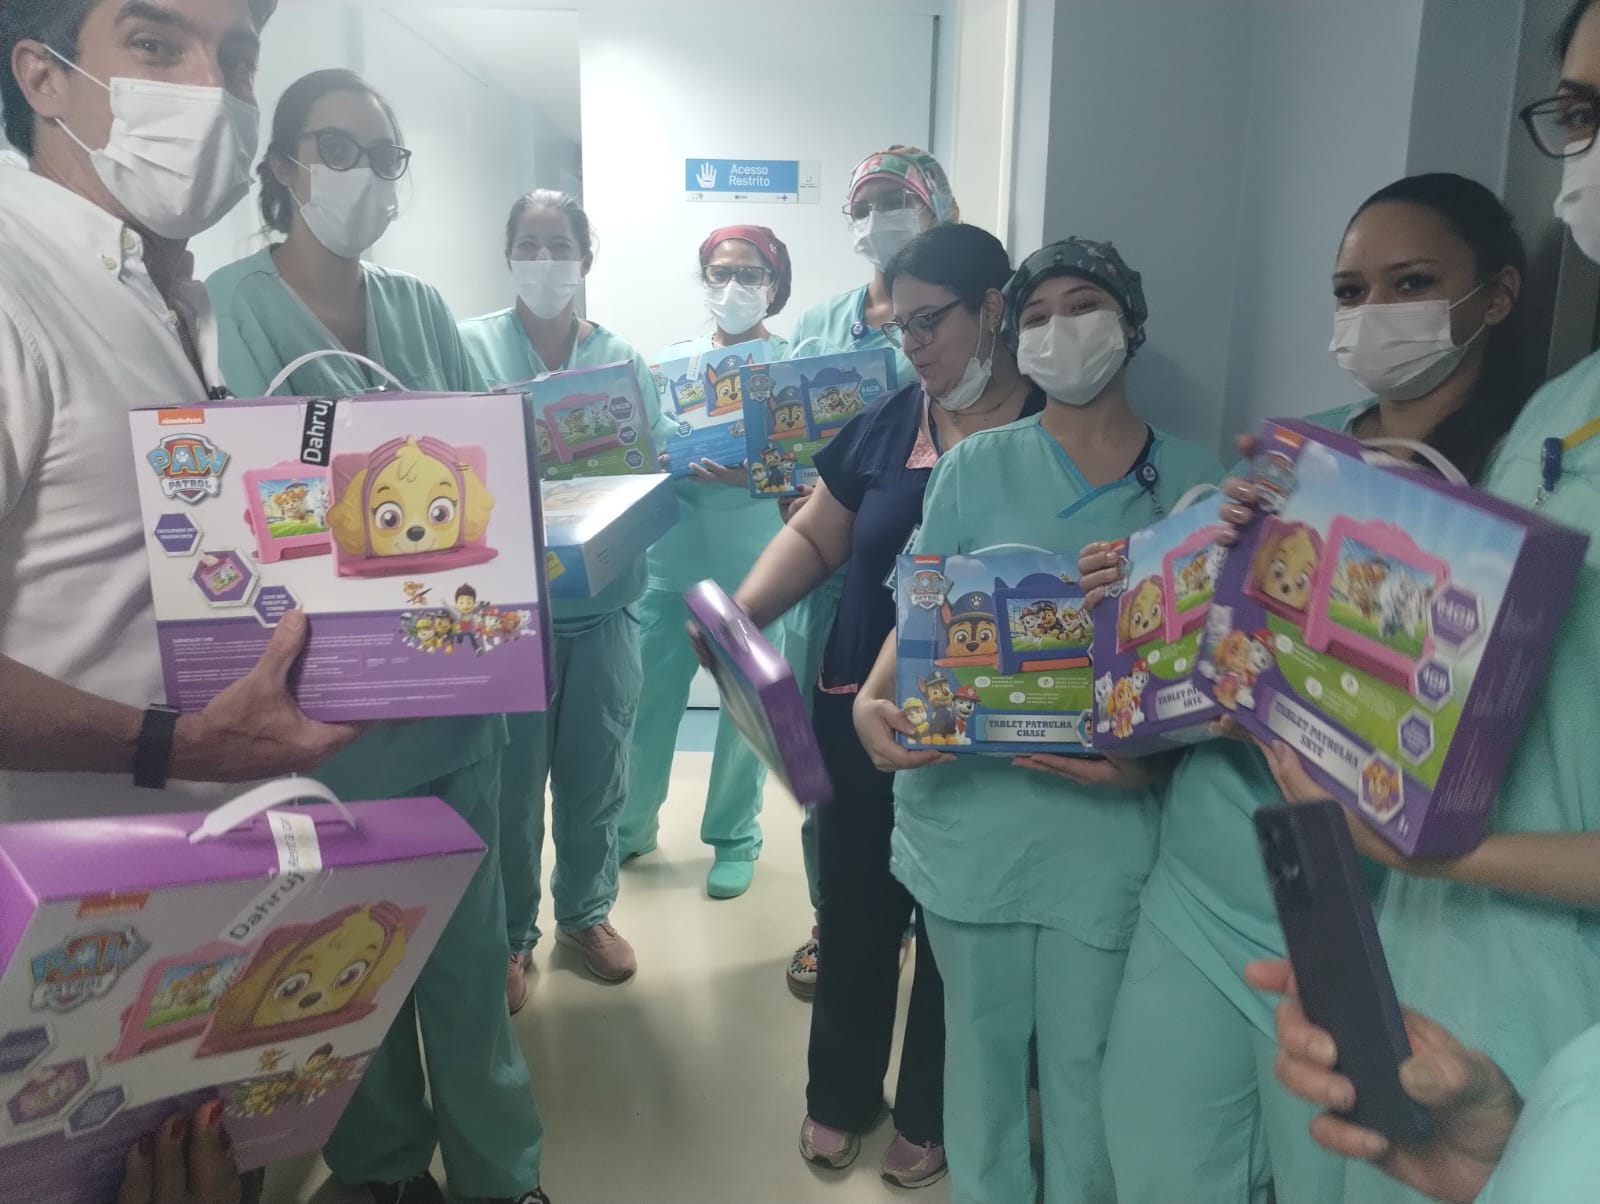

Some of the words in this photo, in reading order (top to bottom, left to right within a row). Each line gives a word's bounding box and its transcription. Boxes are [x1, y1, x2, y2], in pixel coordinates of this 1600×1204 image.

[730, 164, 769, 175] Acesso
[728, 175, 770, 187] Restrito
[303, 400, 334, 463] Dahruj
[146, 445, 230, 479] PAW
[168, 479, 212, 490] PATROL
[988, 720, 1024, 729] TABLET
[1025, 720, 1072, 729] PATRULHA
[1016, 729, 1047, 737] CHASE
[229, 871, 305, 939] Dahruj
